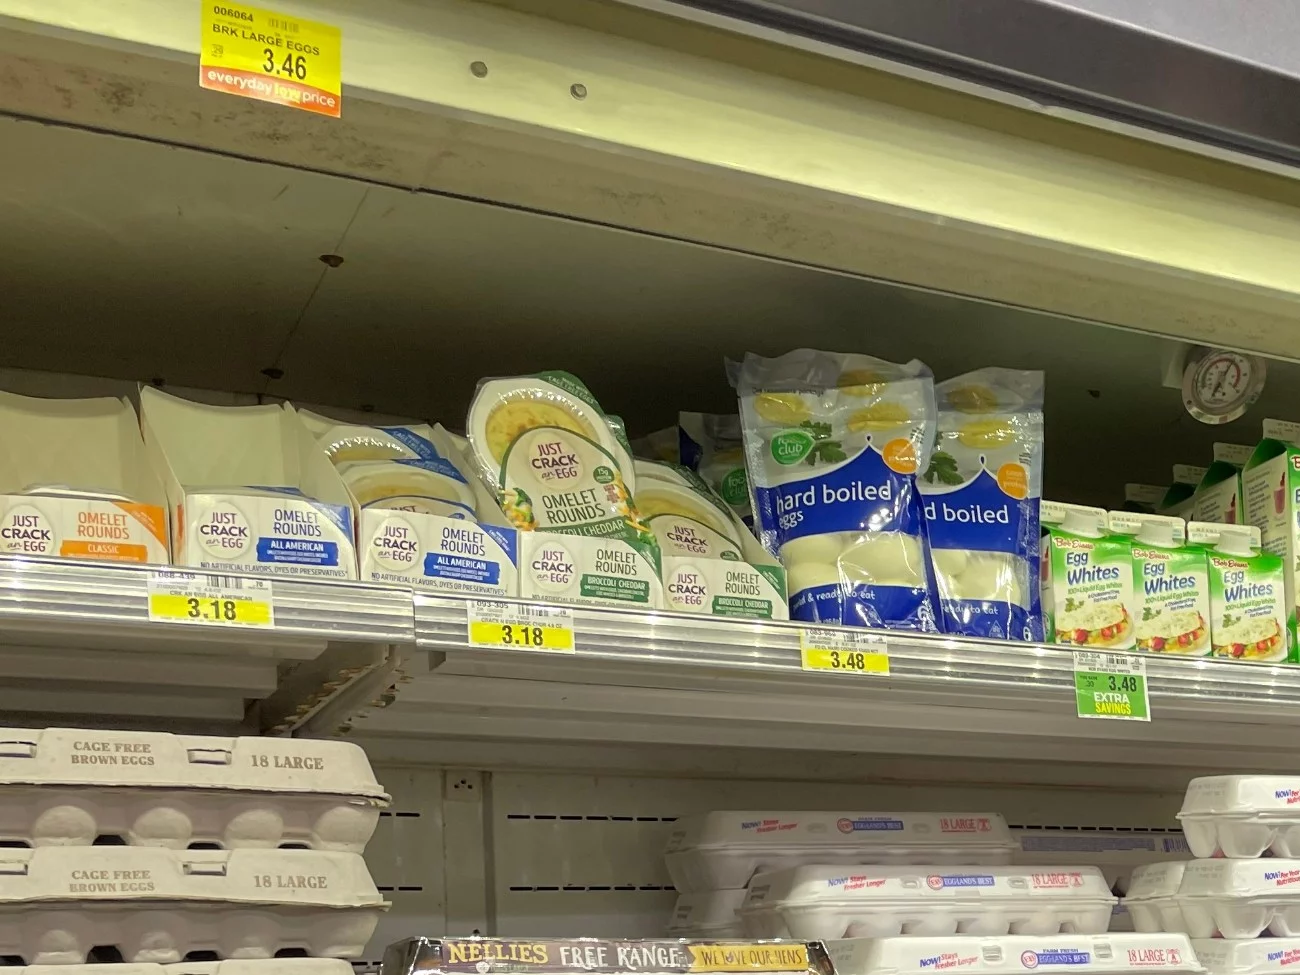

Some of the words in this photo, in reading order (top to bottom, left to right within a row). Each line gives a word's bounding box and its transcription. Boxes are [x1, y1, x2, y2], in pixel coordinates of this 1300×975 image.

[214, 6, 254, 22] 006064
[212, 24, 238, 37] BRK
[242, 30, 283, 47] LARGE
[287, 41, 320, 55] EGGS
[263, 48, 306, 80] 3.46
[207, 70, 273, 95] everyday
[274, 82, 300, 101] low
[302, 91, 335, 108] price
[537, 442, 562, 456] JUST
[531, 454, 579, 469] CRACK
[542, 488, 597, 509] OMELET
[776, 485, 816, 516] hard
[822, 479, 892, 504] boiled
[12, 515, 39, 527] JUST
[78, 511, 128, 526] OMELET
[211, 512, 237, 524] JUST
[274, 509, 318, 523] OMELET
[546, 503, 606, 524] ROUNDS
[778, 511, 804, 530] eggs
[942, 503, 1009, 524] boiled
[1, 528, 51, 541] CRACK
[77, 525, 130, 540] ROUNDS
[200, 525, 248, 537] CRACK
[274, 522, 322, 537] ROUNDS
[385, 526, 408, 538] JUST
[442, 527, 484, 544] OMELET
[583, 519, 625, 537] CHEDDAR
[271, 540, 284, 550] ALL
[286, 541, 324, 551] AMERICAN
[373, 537, 417, 551] CRACK
[441, 539, 485, 556] ROUNDS
[437, 556, 450, 566] ALL
[451, 559, 486, 570] AMERICAN
[542, 551, 565, 562] JUST
[596, 549, 637, 563] OMELET
[1066, 552, 1089, 566] Egg
[532, 561, 573, 574] CRACK
[595, 561, 637, 576] ROUNDS
[1067, 565, 1120, 585] Whites
[1144, 562, 1165, 576] Egg
[1145, 574, 1196, 595] Whites
[1224, 571, 1245, 584] Egg
[1225, 582, 1273, 602] Whites
[187, 598, 237, 620] 3.18
[502, 625, 543, 646] 3.18
[830, 651, 865, 670] 3.48
[1108, 676, 1137, 692] 3.48
[1093, 692, 1130, 704] EXTRA
[1095, 703, 1131, 715] SAVINGS
[73, 741, 110, 753] CAGE
[113, 742, 151, 754] FREE
[71, 754, 117, 766] BROWN
[121, 755, 155, 767] EGGS
[251, 754, 270, 769] 18
[273, 755, 324, 771] LARGE
[71, 870, 109, 881] CAGE
[113, 870, 151, 881] FREE
[253, 875, 272, 888] 18
[277, 875, 328, 890] LARGE
[69, 882, 117, 893] BROWN
[121, 881, 155, 892] EGGS
[560, 946, 609, 970] FREE
[617, 946, 680, 970] RANGE
